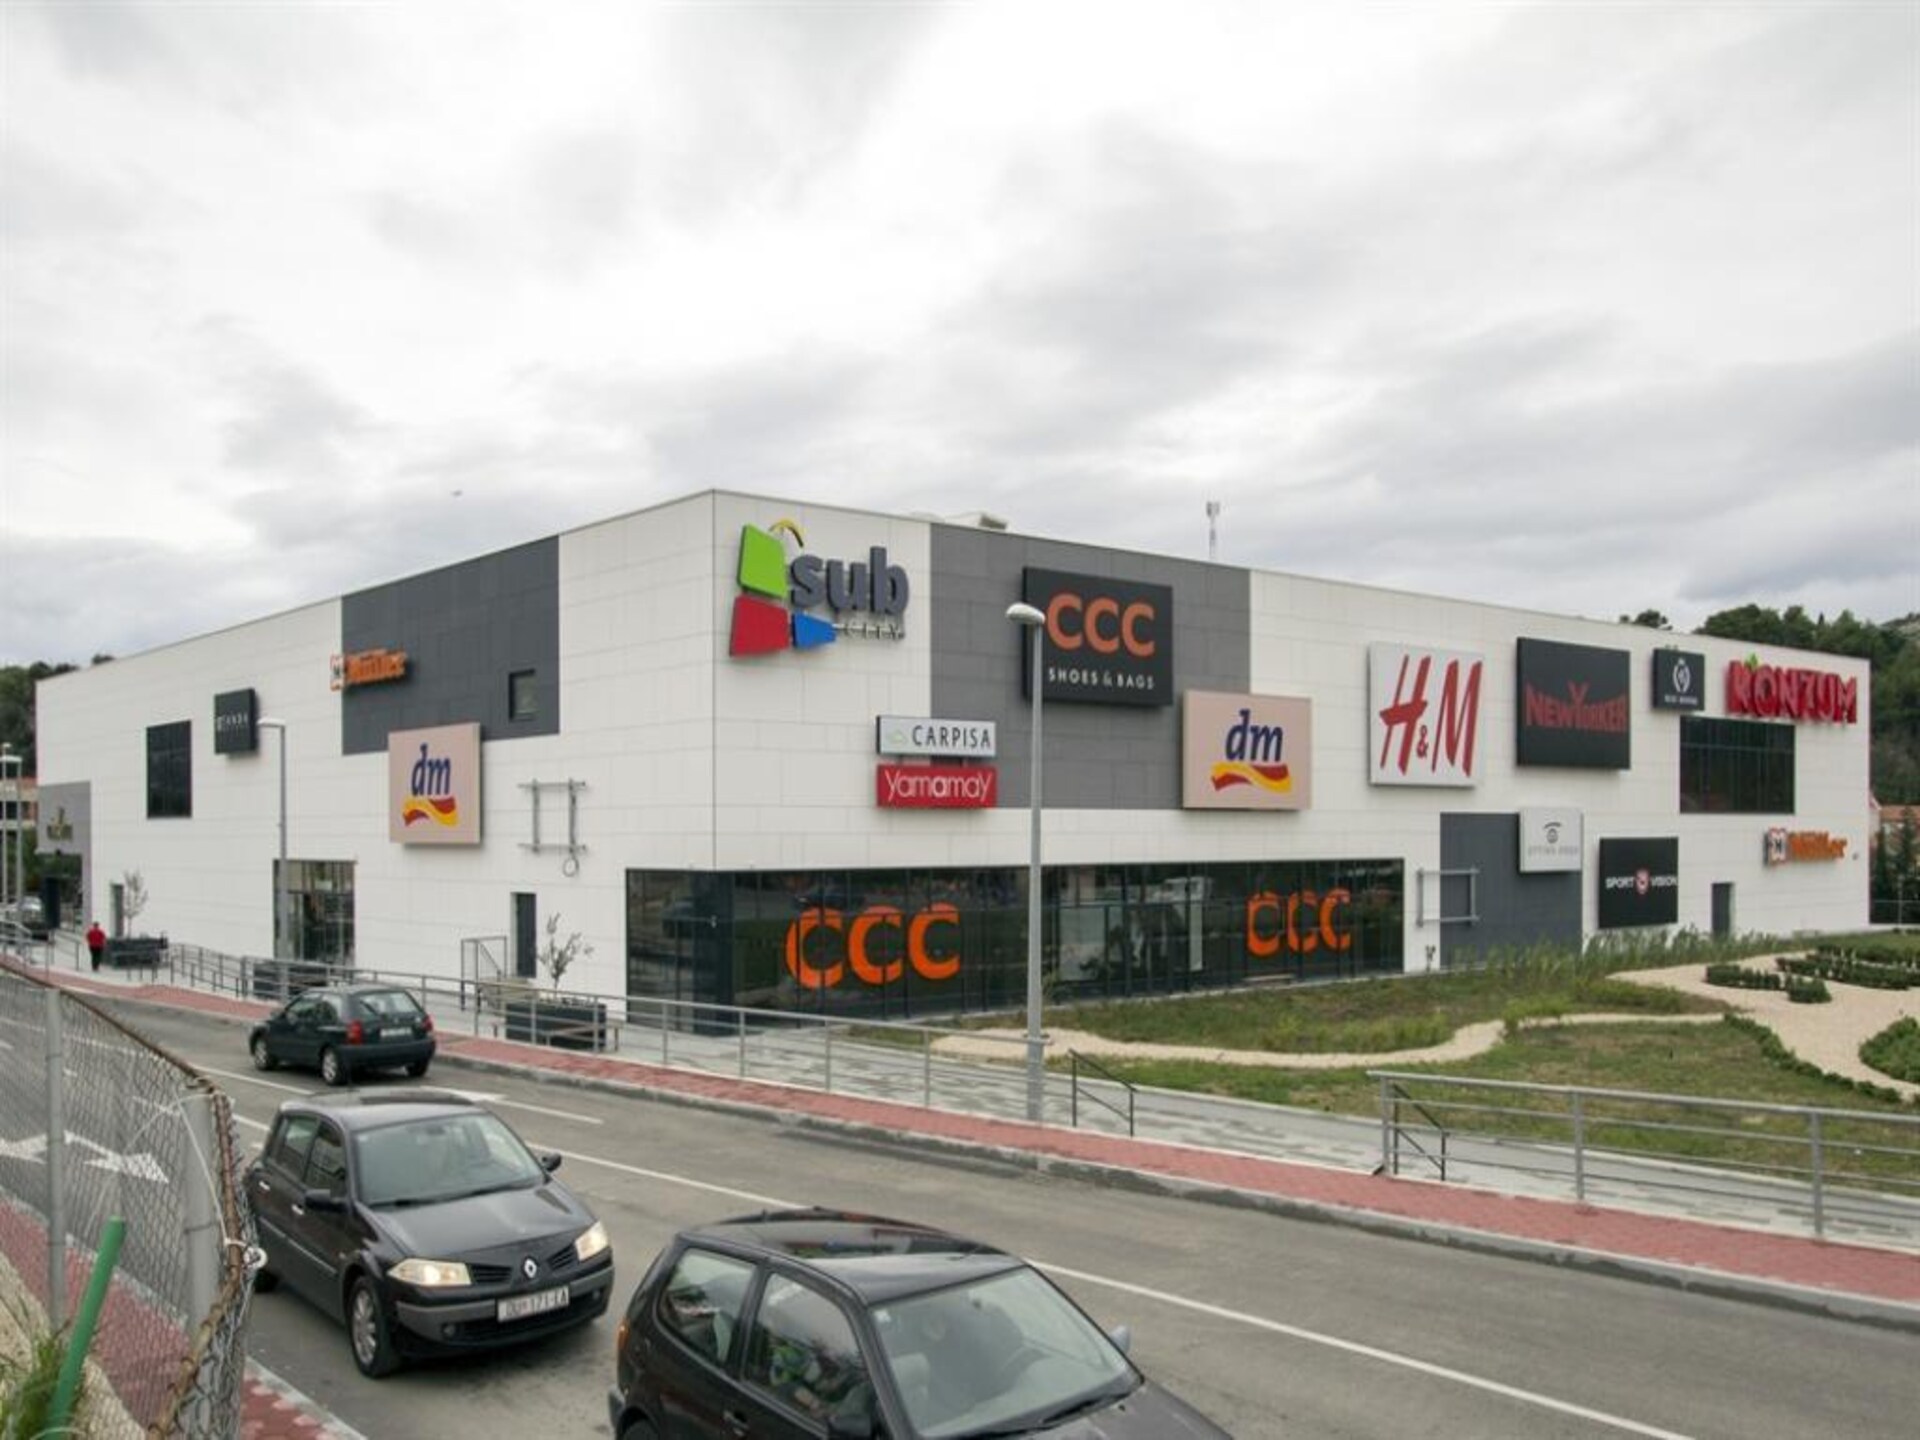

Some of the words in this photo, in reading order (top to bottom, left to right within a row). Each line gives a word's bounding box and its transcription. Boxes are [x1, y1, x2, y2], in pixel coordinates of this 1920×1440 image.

[790, 546, 909, 615] sub
[1047, 593, 1156, 658] CCC
[1049, 668, 1098, 685] SHOES
[1117, 673, 1155, 690] BAGS
[1728, 659, 1857, 724] KONZUM
[911, 725, 991, 749] CARPISA
[1225, 708, 1283, 762] dm
[1379, 655, 1483, 778] H&M
[411, 742, 451, 796] dm
[785, 902, 961, 989] CCC
[1246, 888, 1352, 957] CCC
